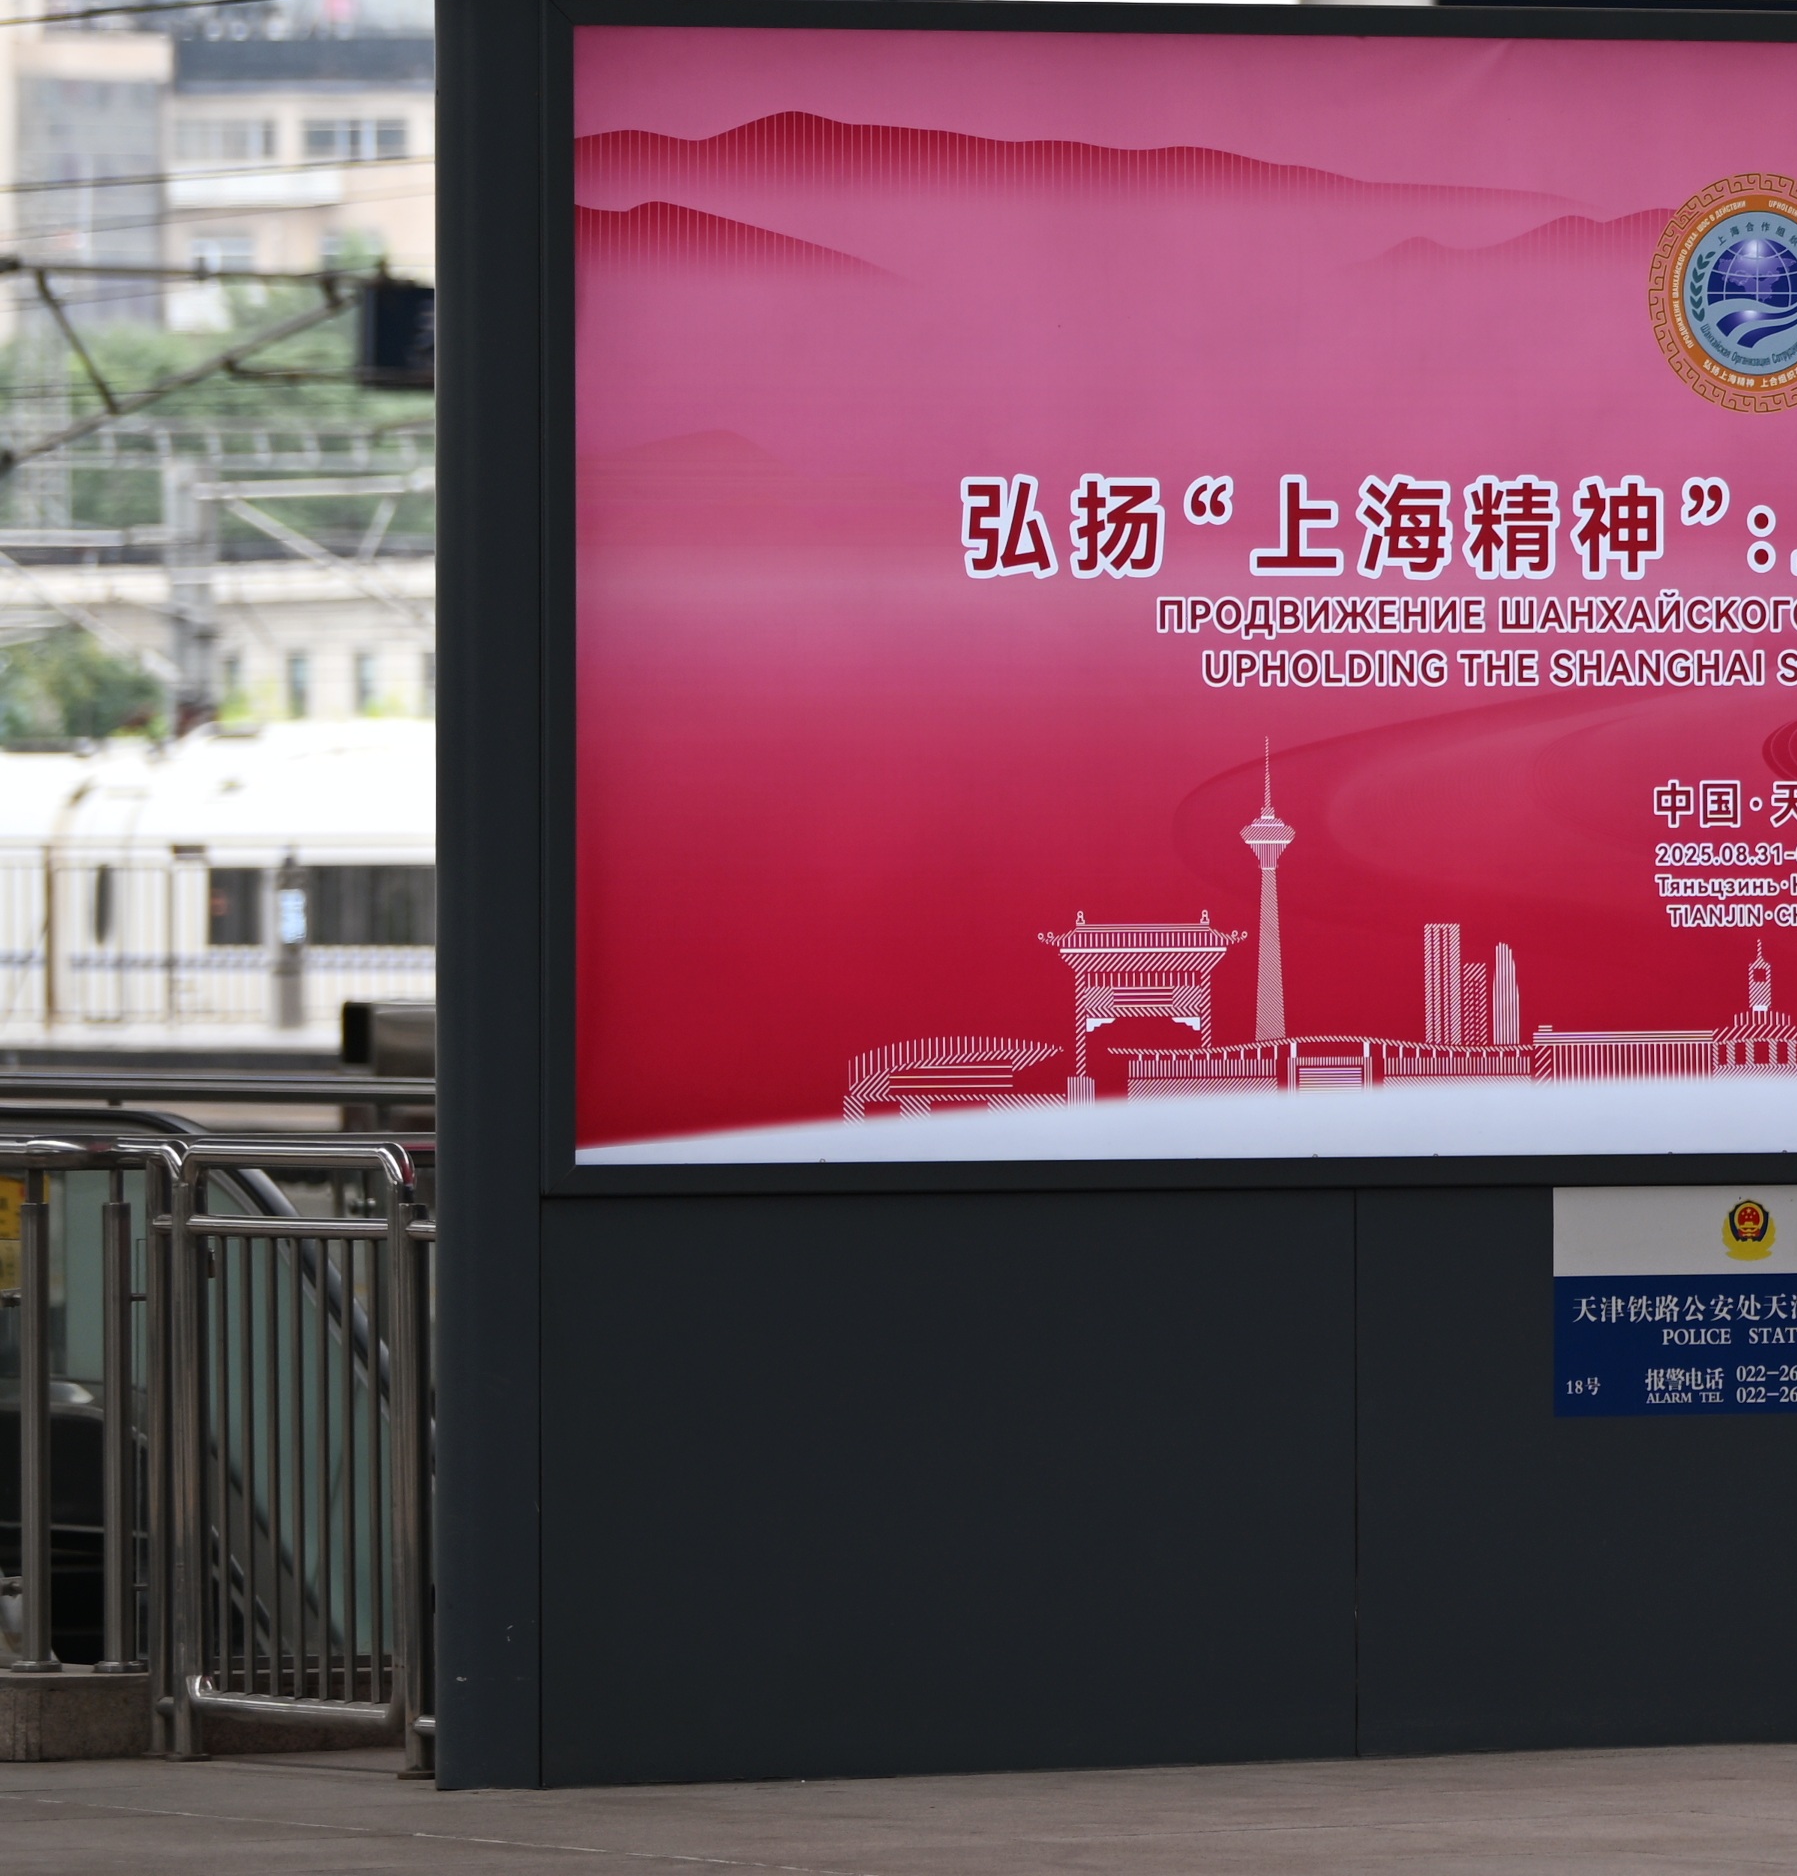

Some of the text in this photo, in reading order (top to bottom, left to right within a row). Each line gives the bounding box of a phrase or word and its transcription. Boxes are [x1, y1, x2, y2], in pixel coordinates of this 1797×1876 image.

[1157, 595, 1487, 638] ПРОДВИЖЕНИЕ
[1202, 650, 1448, 687] UPHOLDING
[1457, 650, 1539, 687] THE
[1549, 650, 1765, 687] SHANGHAI
[1661, 1328, 1732, 1346] POLICE
[1566, 1377, 1601, 1396] 18号
[1644, 1367, 1725, 1392] 报警电话
[1645, 1392, 1692, 1404] ALARM
[1699, 1391, 1725, 1403] TEL
